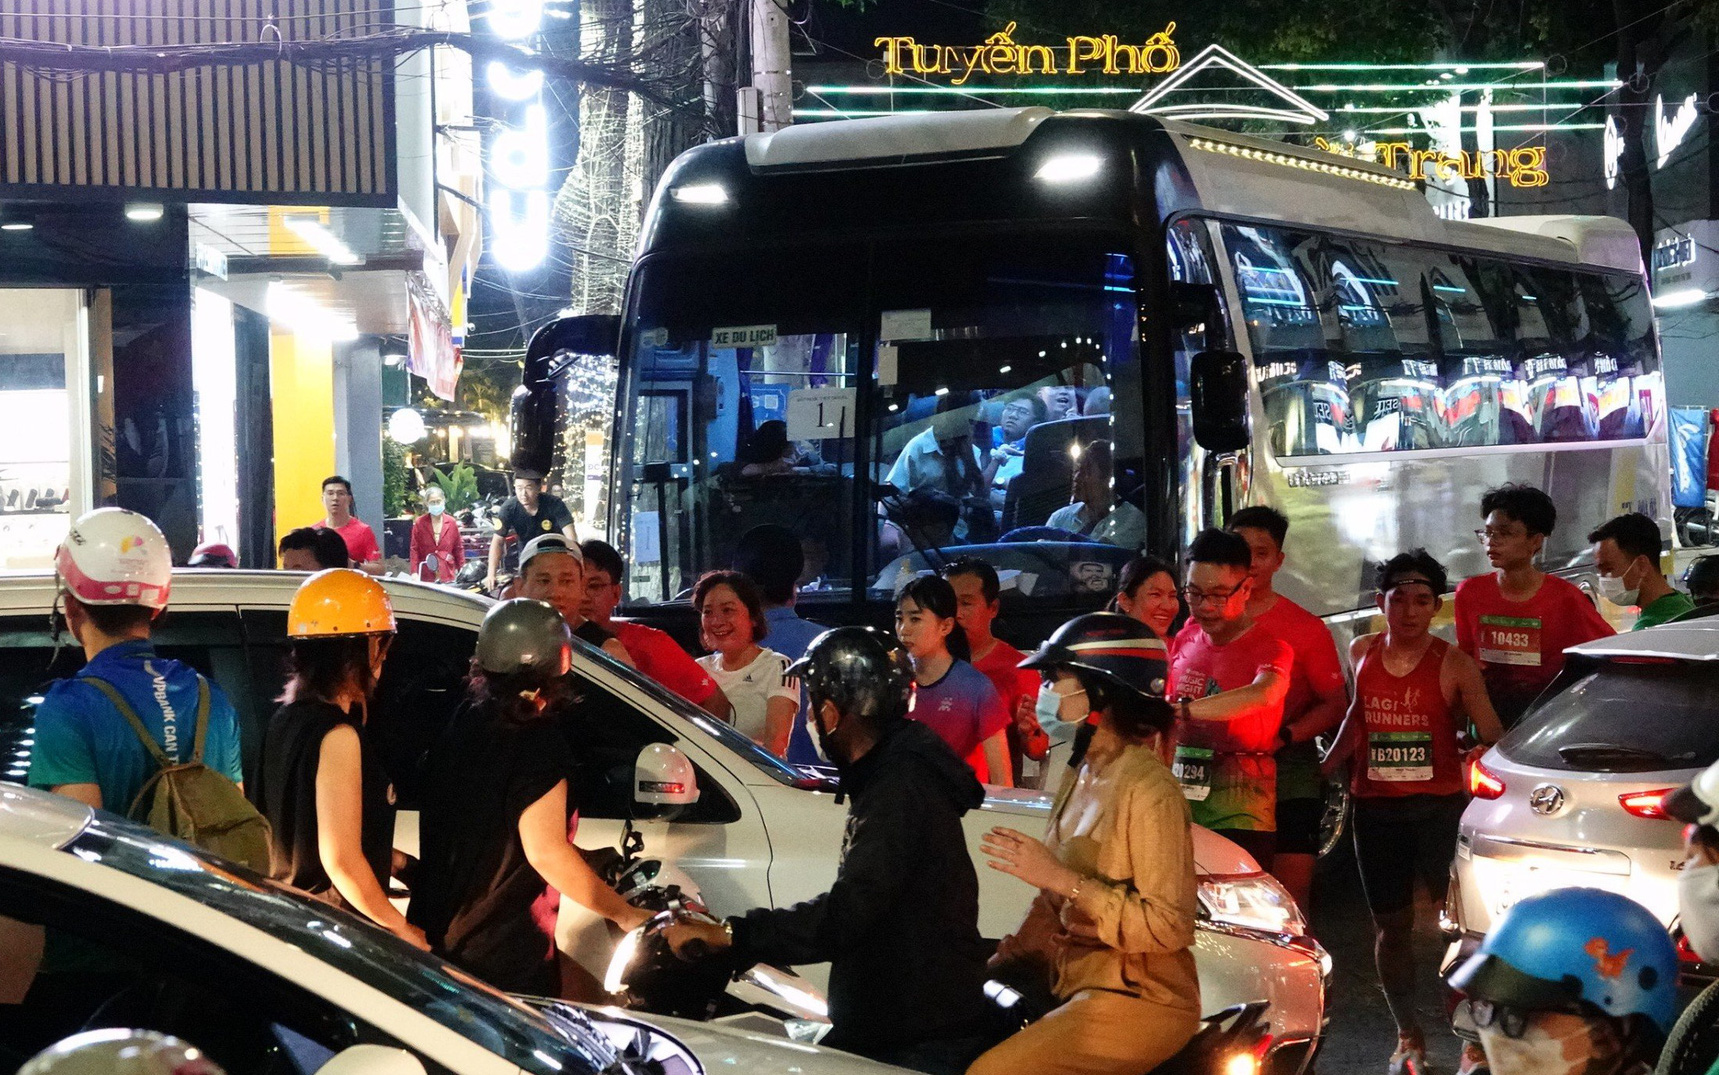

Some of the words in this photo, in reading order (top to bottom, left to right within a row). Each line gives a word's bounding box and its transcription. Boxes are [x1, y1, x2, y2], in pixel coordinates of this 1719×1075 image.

[874, 21, 1058, 85] Tuyến
[1066, 21, 1180, 74] Phố
[1373, 142, 1549, 187] Trang
[715, 332, 729, 344] XE
[732, 331, 747, 343] DU
[816, 402, 825, 427] 1
[1491, 631, 1529, 647] 10433
[152, 676, 176, 722] VPBANK
[1364, 711, 1430, 727] RUNNERS
